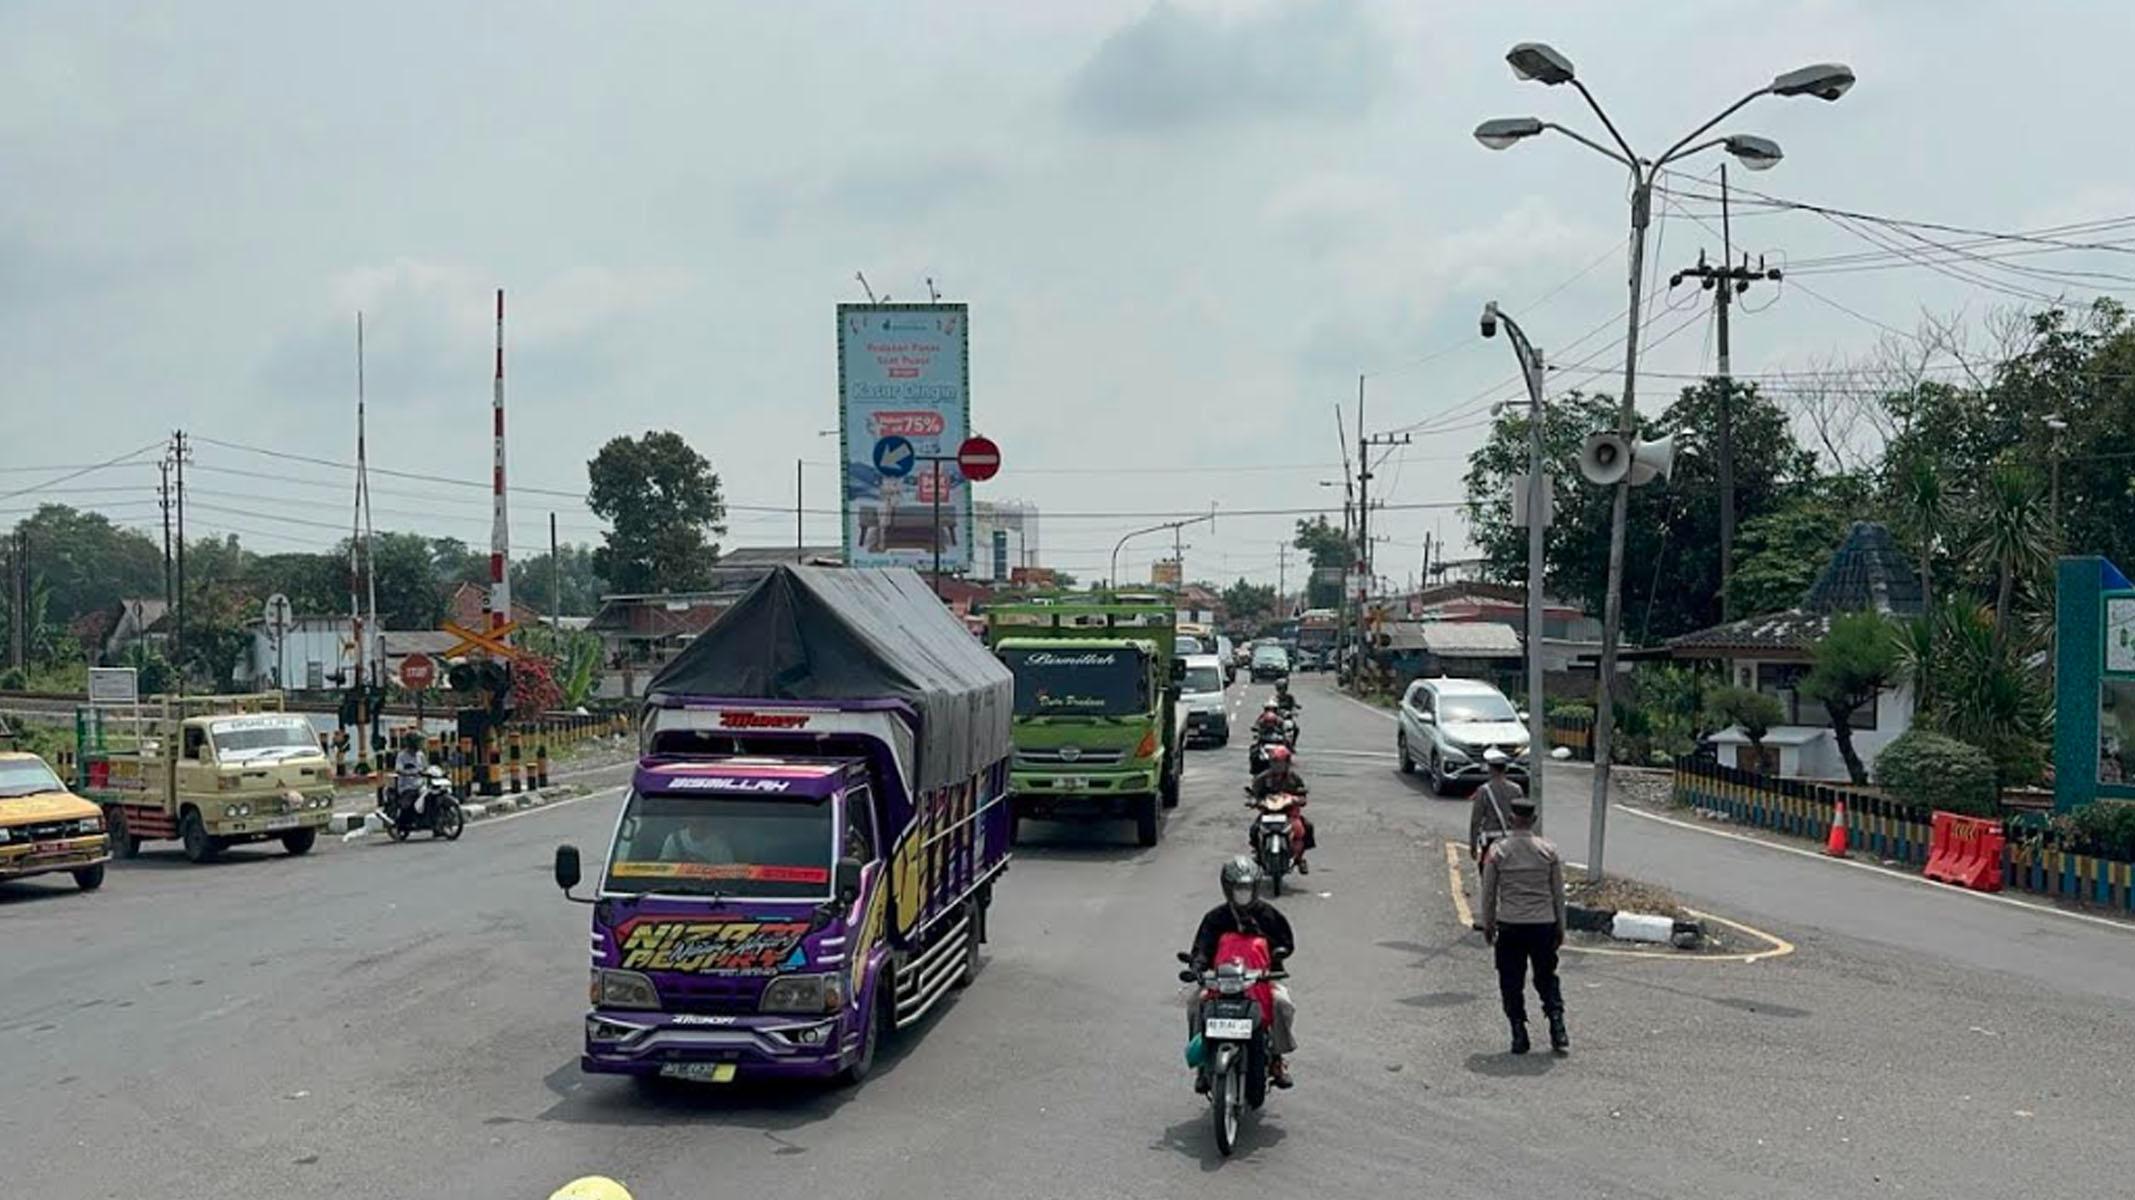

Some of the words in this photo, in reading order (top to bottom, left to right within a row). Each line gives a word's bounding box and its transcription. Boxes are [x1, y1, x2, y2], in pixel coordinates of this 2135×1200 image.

[904, 416, 940, 432] 75%
[1025, 652, 1115, 664] Bismillah
[406, 667, 428, 678] STOP
